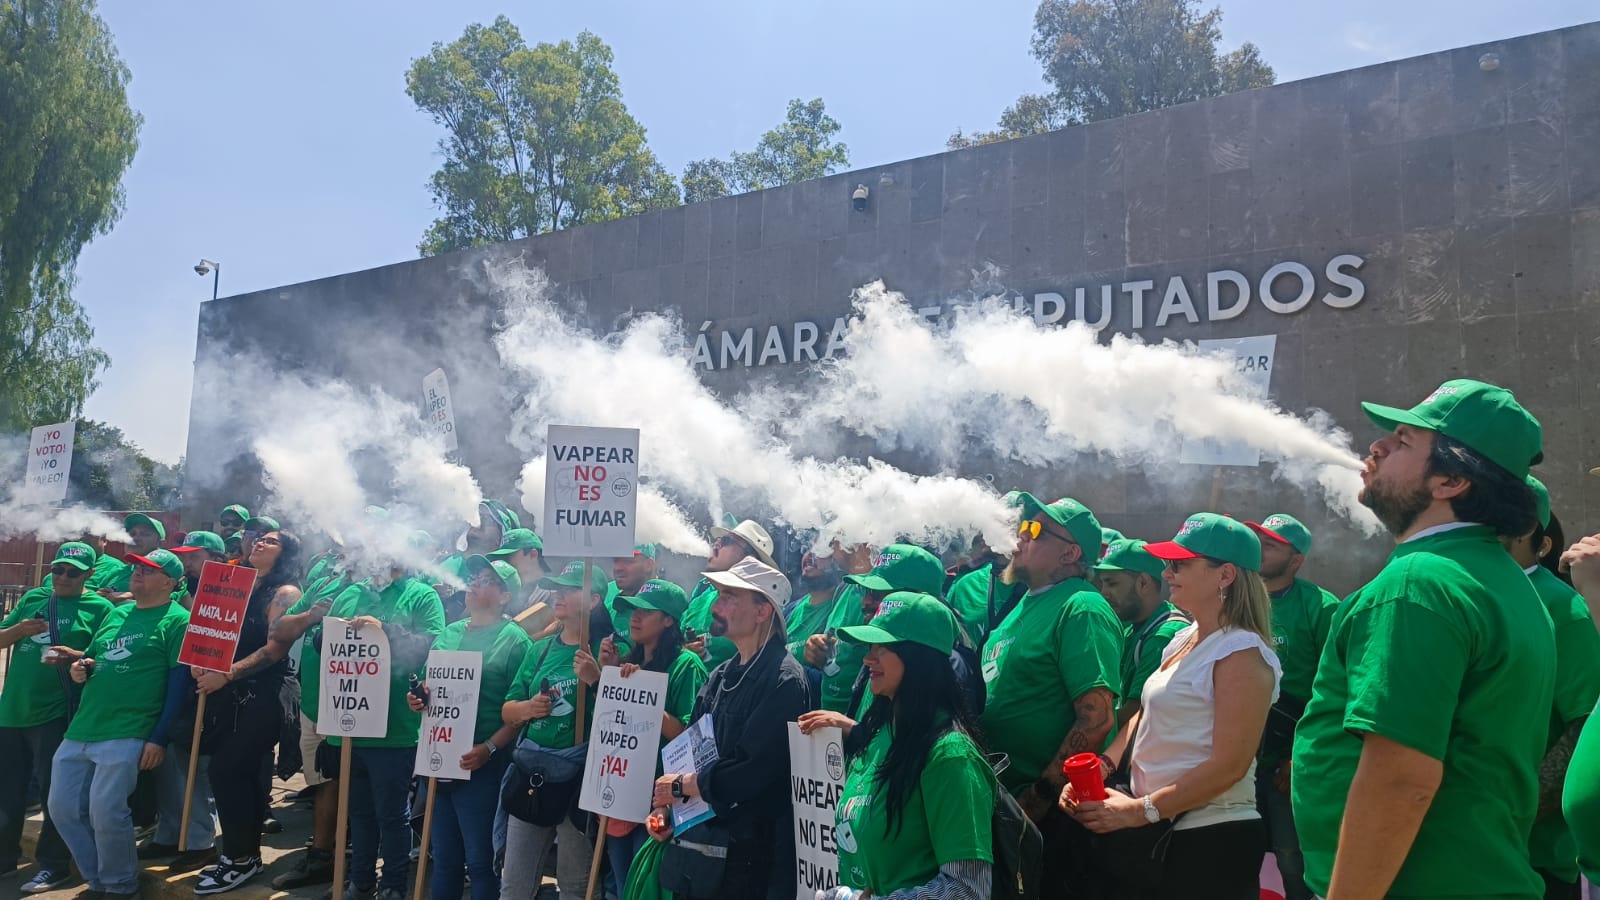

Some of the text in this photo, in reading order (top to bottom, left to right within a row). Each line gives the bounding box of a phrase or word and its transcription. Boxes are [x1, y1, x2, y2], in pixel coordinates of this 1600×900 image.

[688, 314, 850, 370] ÁMARA
[1013, 254, 1366, 333] PUTADOS
[44, 430, 61, 443] ¡YO
[36, 443, 66, 457] VOTO!
[552, 444, 635, 464] VAPEAR
[574, 464, 607, 482] NO
[578, 484, 602, 502] ES
[555, 508, 627, 527] FUMAR
[198, 603, 238, 624] MATA, LA
[345, 626, 362, 640] EL
[329, 642, 380, 658] VAPEO
[329, 658, 379, 675] SALVÓ
[428, 666, 475, 681] REGULEN
[339, 678, 358, 692] MI
[437, 686, 449, 699] EL
[332, 695, 370, 711] VIDA
[602, 685, 658, 707] REGULEN
[427, 705, 460, 719] VAPEO
[615, 709, 627, 725] EL
[429, 725, 452, 745] ¡YA!
[600, 730, 638, 750] VAPEO
[600, 755, 628, 778] ¡YA!
[799, 817, 817, 849] NO
[798, 857, 840, 892] FUMA
